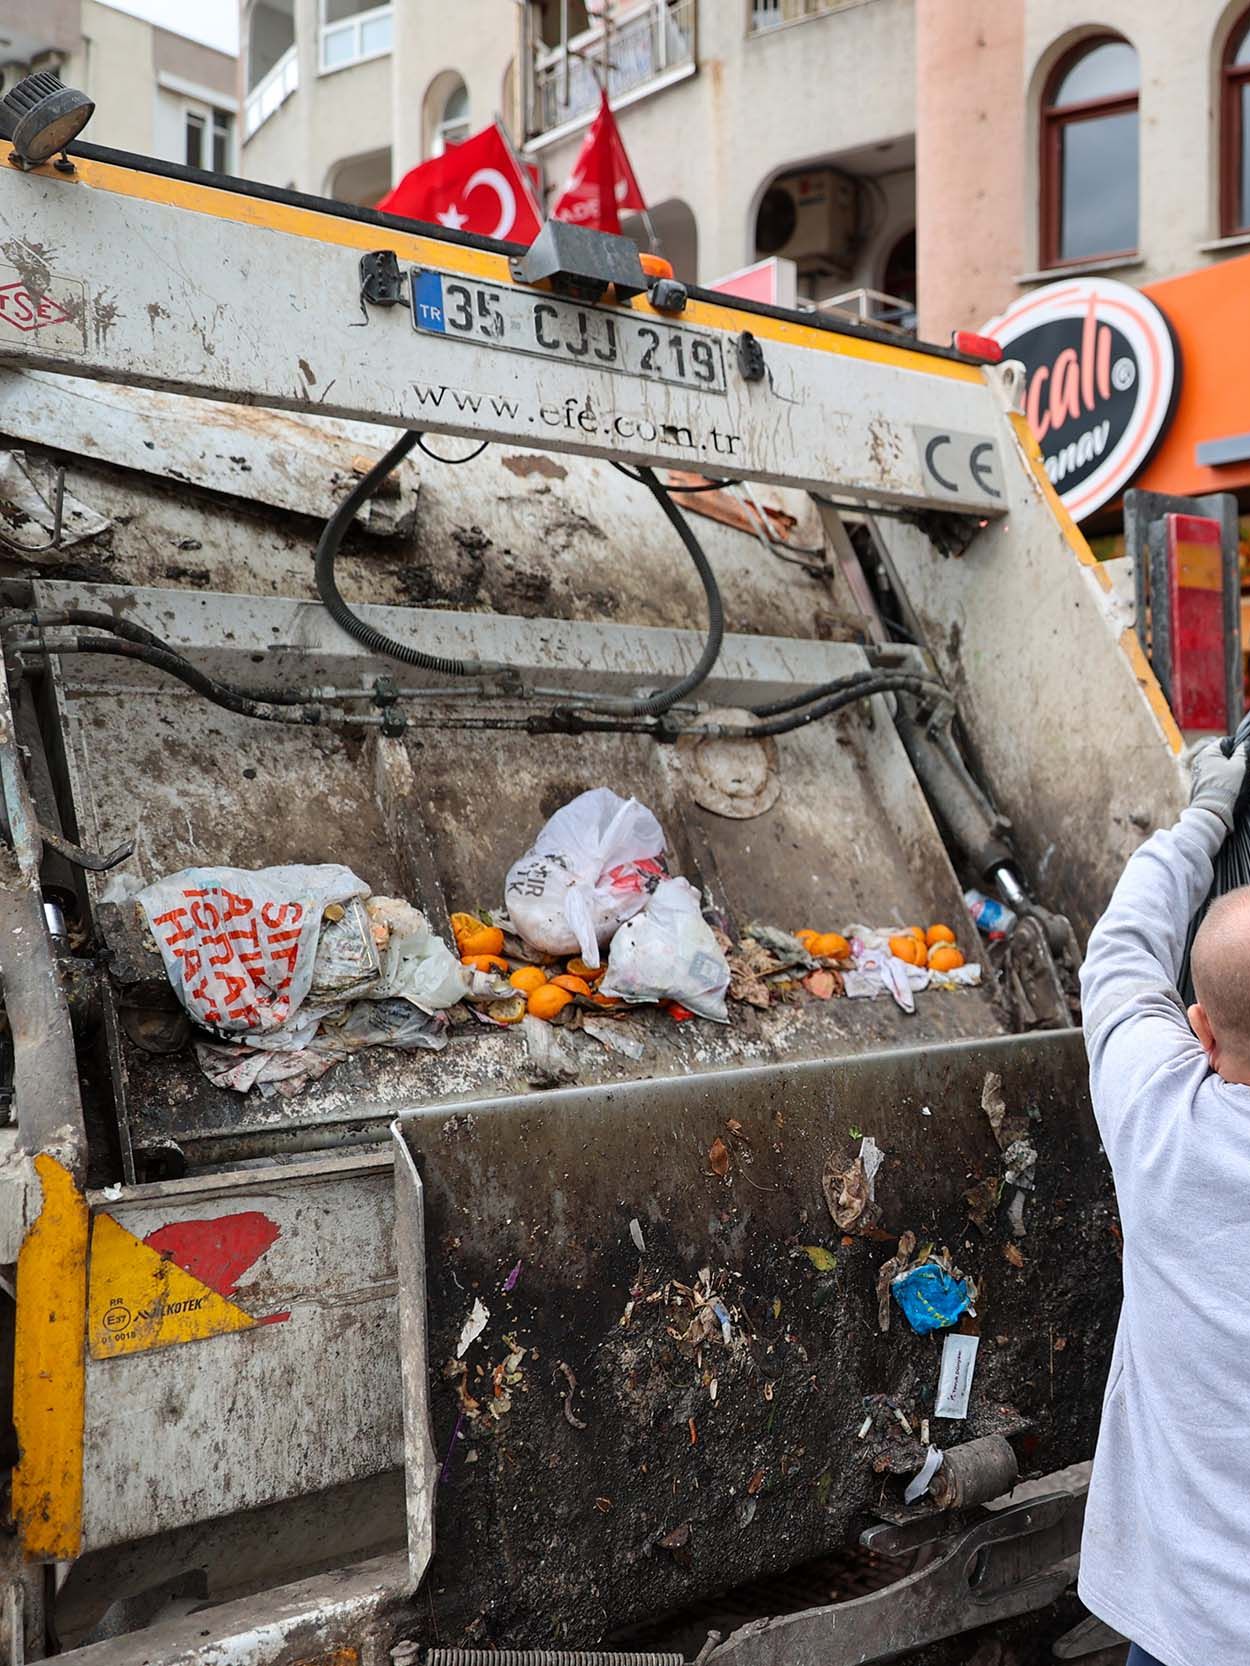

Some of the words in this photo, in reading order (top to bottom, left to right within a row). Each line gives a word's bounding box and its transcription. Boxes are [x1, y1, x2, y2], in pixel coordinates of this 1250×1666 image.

[0, 290, 52, 321] TSE
[419, 303, 442, 321] TR
[446, 284, 505, 337] 35
[533, 304, 617, 362] CJJ
[637, 328, 715, 382] 219
[410, 384, 742, 455] www.efe.com.tr
